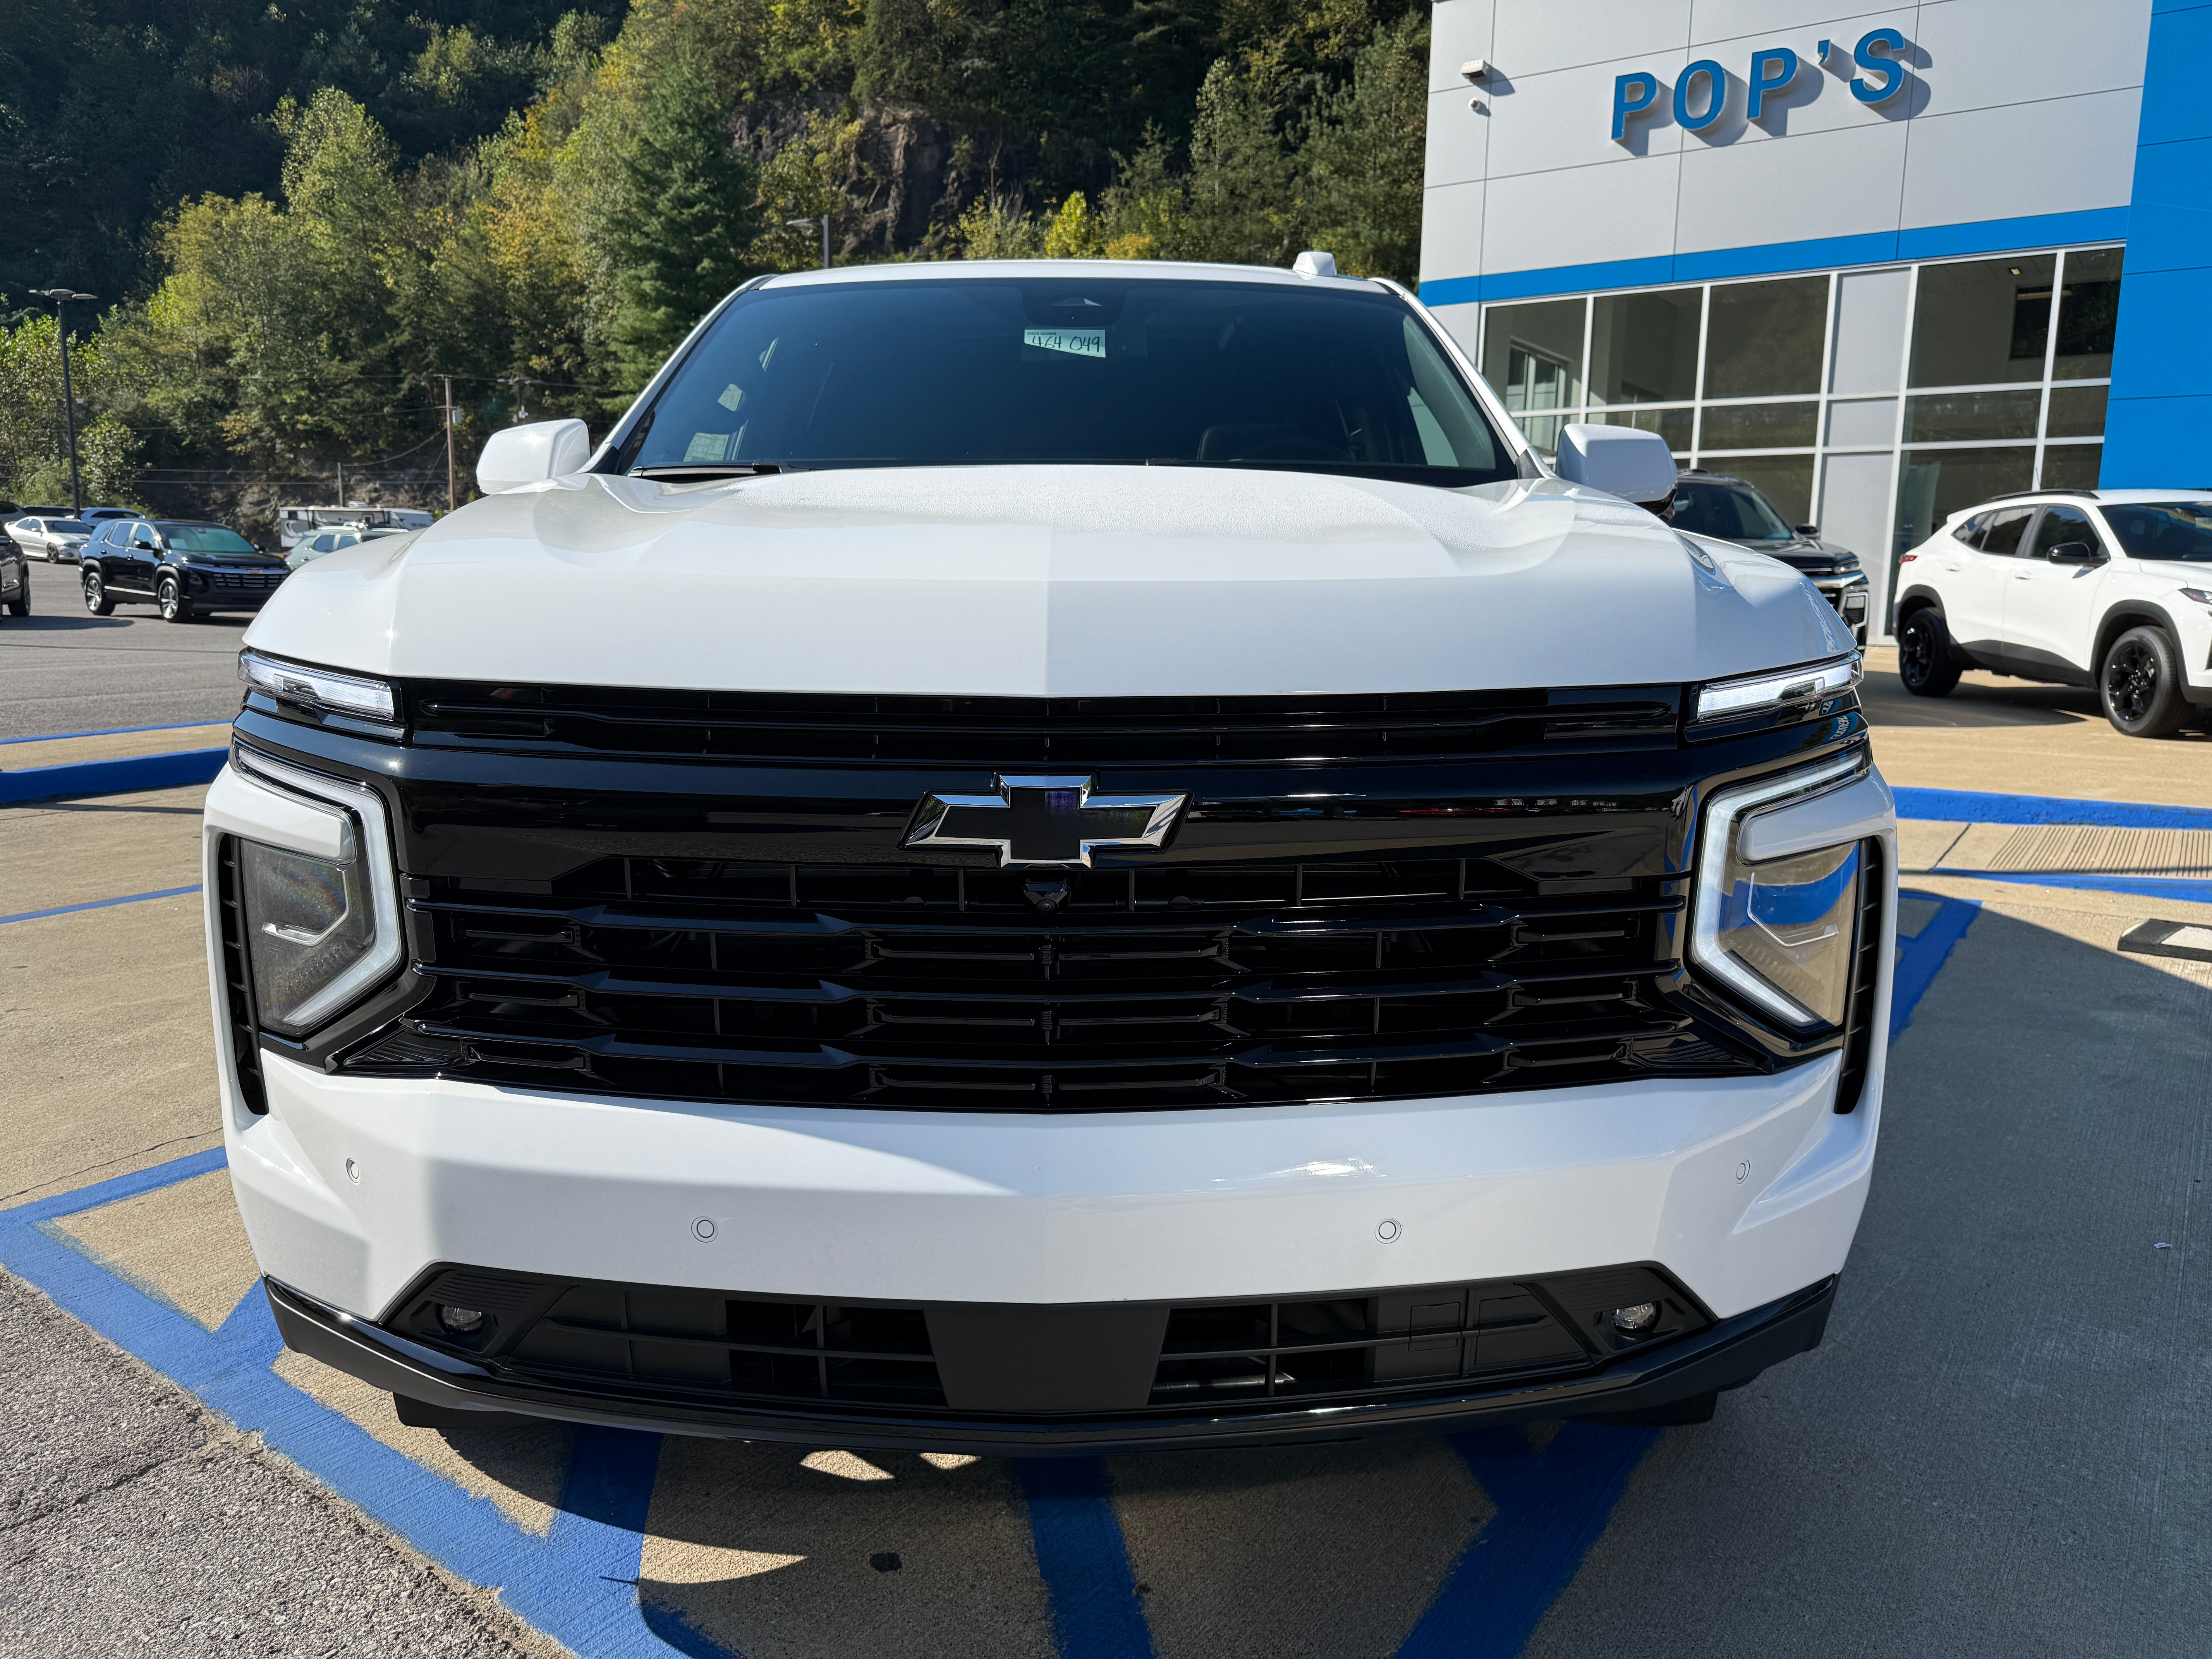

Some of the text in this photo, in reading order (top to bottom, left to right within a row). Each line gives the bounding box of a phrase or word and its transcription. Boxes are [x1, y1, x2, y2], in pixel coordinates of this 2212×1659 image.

[1611, 28, 1906, 140] POP'S
[1032, 336, 1100, 353] 464 049
